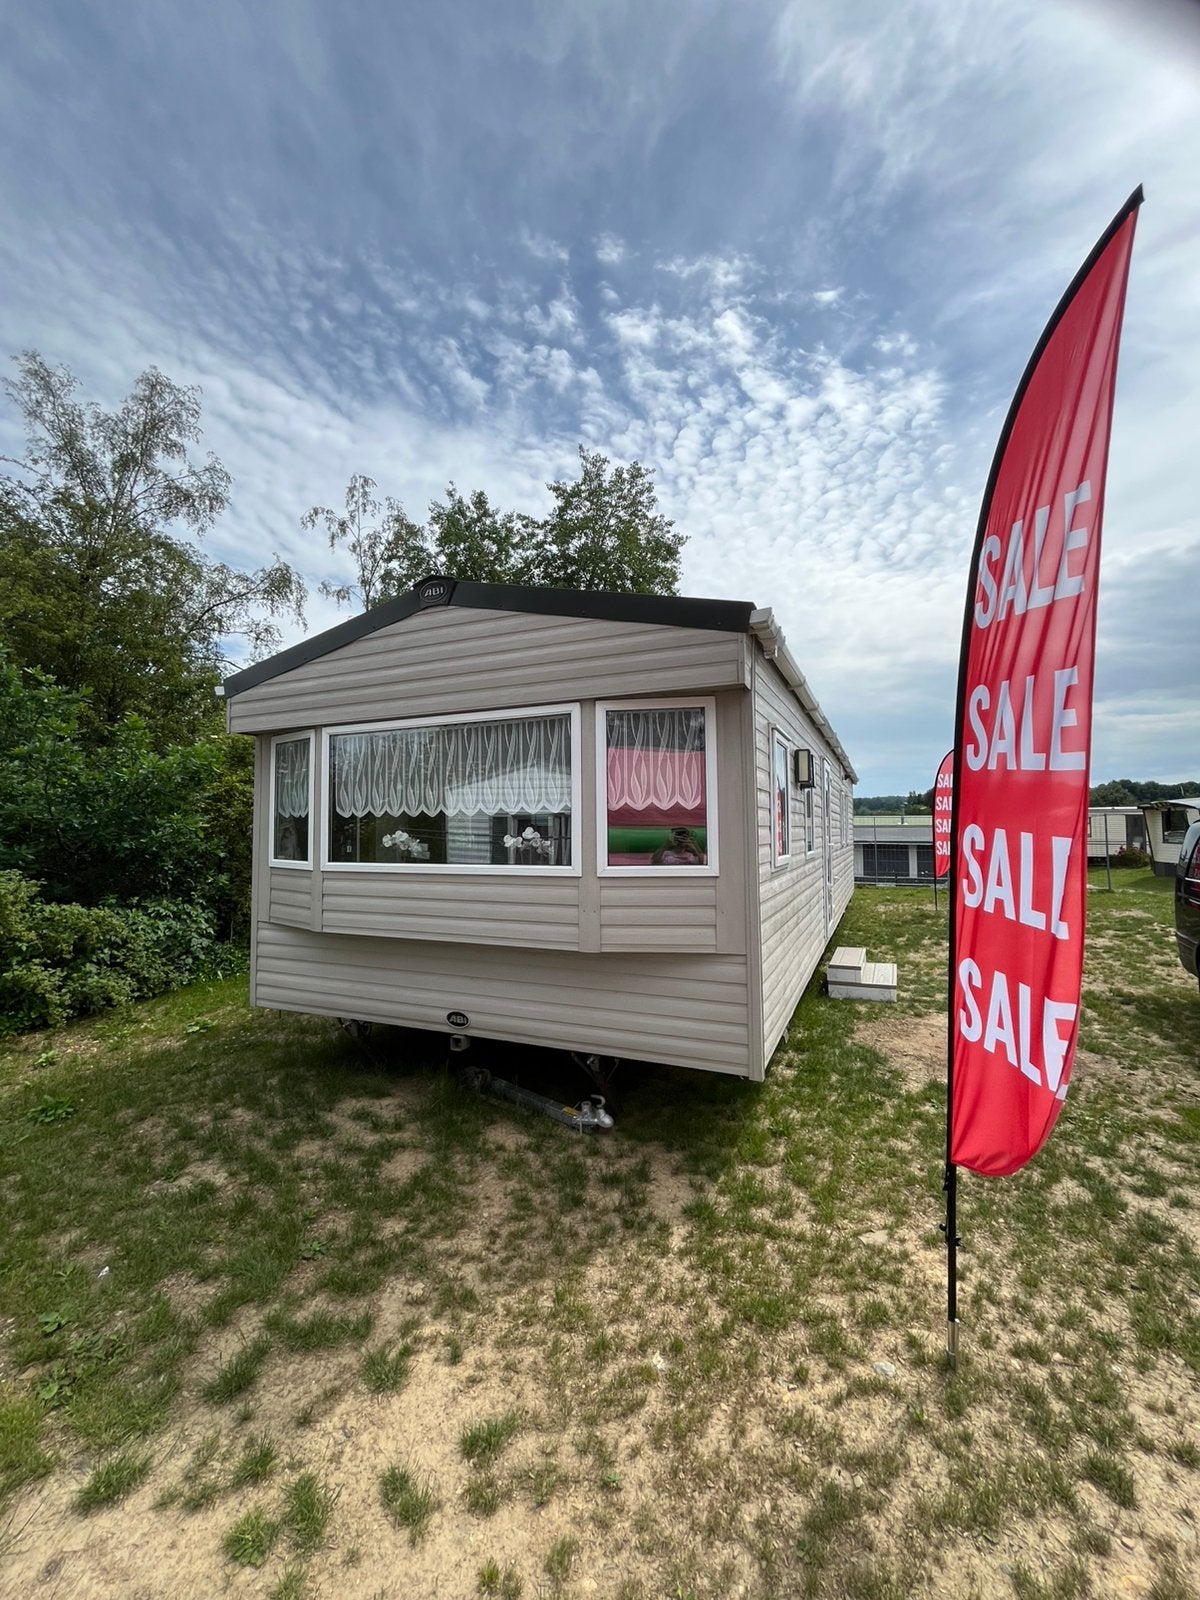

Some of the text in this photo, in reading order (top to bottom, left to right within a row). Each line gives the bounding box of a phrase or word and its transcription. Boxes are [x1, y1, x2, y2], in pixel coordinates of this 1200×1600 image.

[975, 480, 1091, 629] SALE
[424, 586, 444, 597] ABI
[966, 665, 1086, 771] SALE
[937, 774, 953, 788] SA
[936, 796, 952, 810] SA
[936, 819, 951, 833] SA
[936, 841, 950, 855] SA
[450, 1014, 467, 1024] ABI
